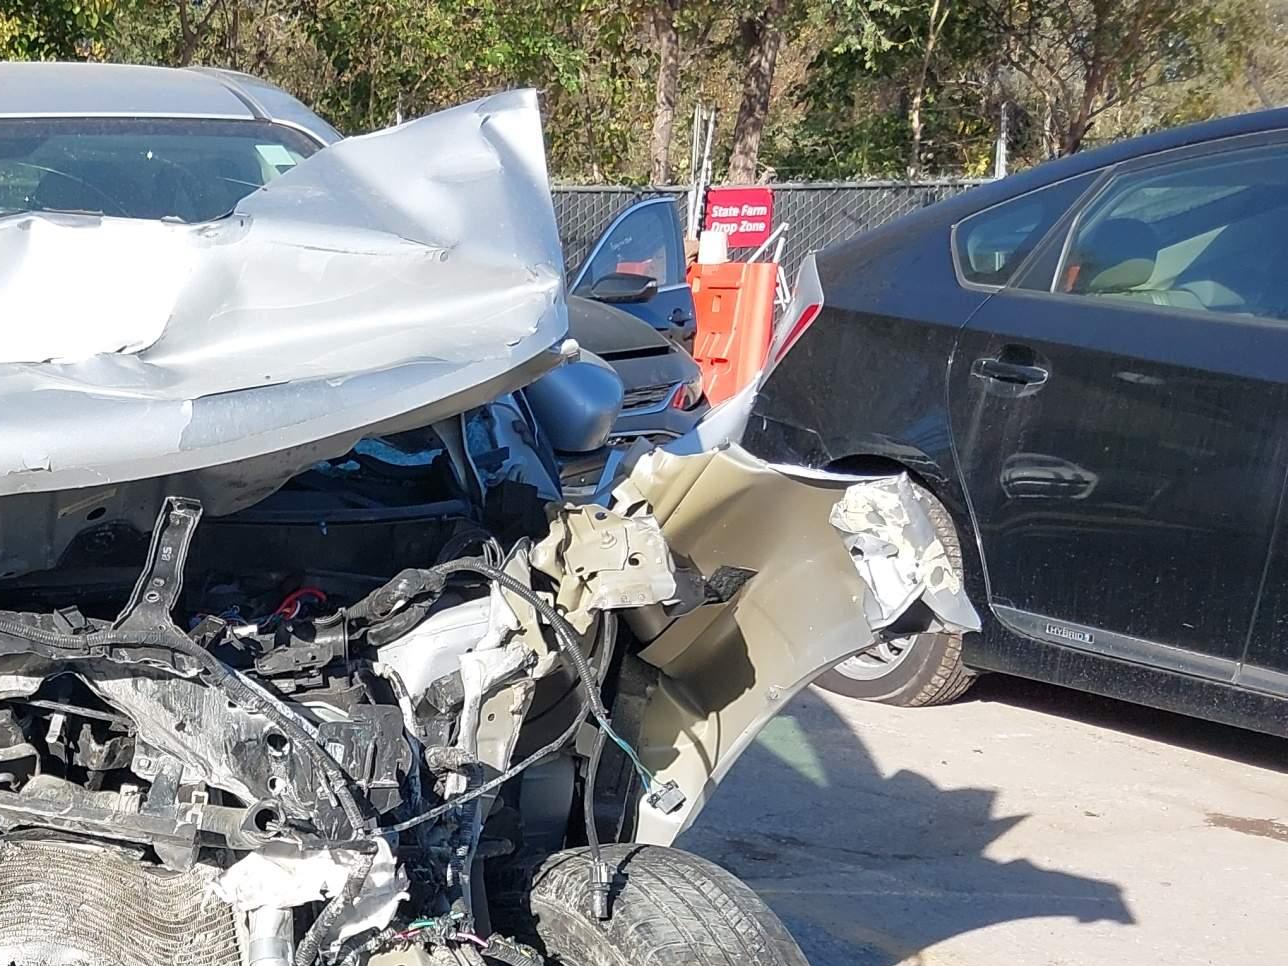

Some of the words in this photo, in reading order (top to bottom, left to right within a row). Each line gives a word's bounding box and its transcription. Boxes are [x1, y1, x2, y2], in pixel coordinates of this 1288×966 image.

[712, 205, 739, 218] State
[741, 204, 768, 217] Farm
[712, 222, 738, 235] Drop
[739, 221, 766, 233] Zone
[1050, 626, 1085, 641] HYBRID
